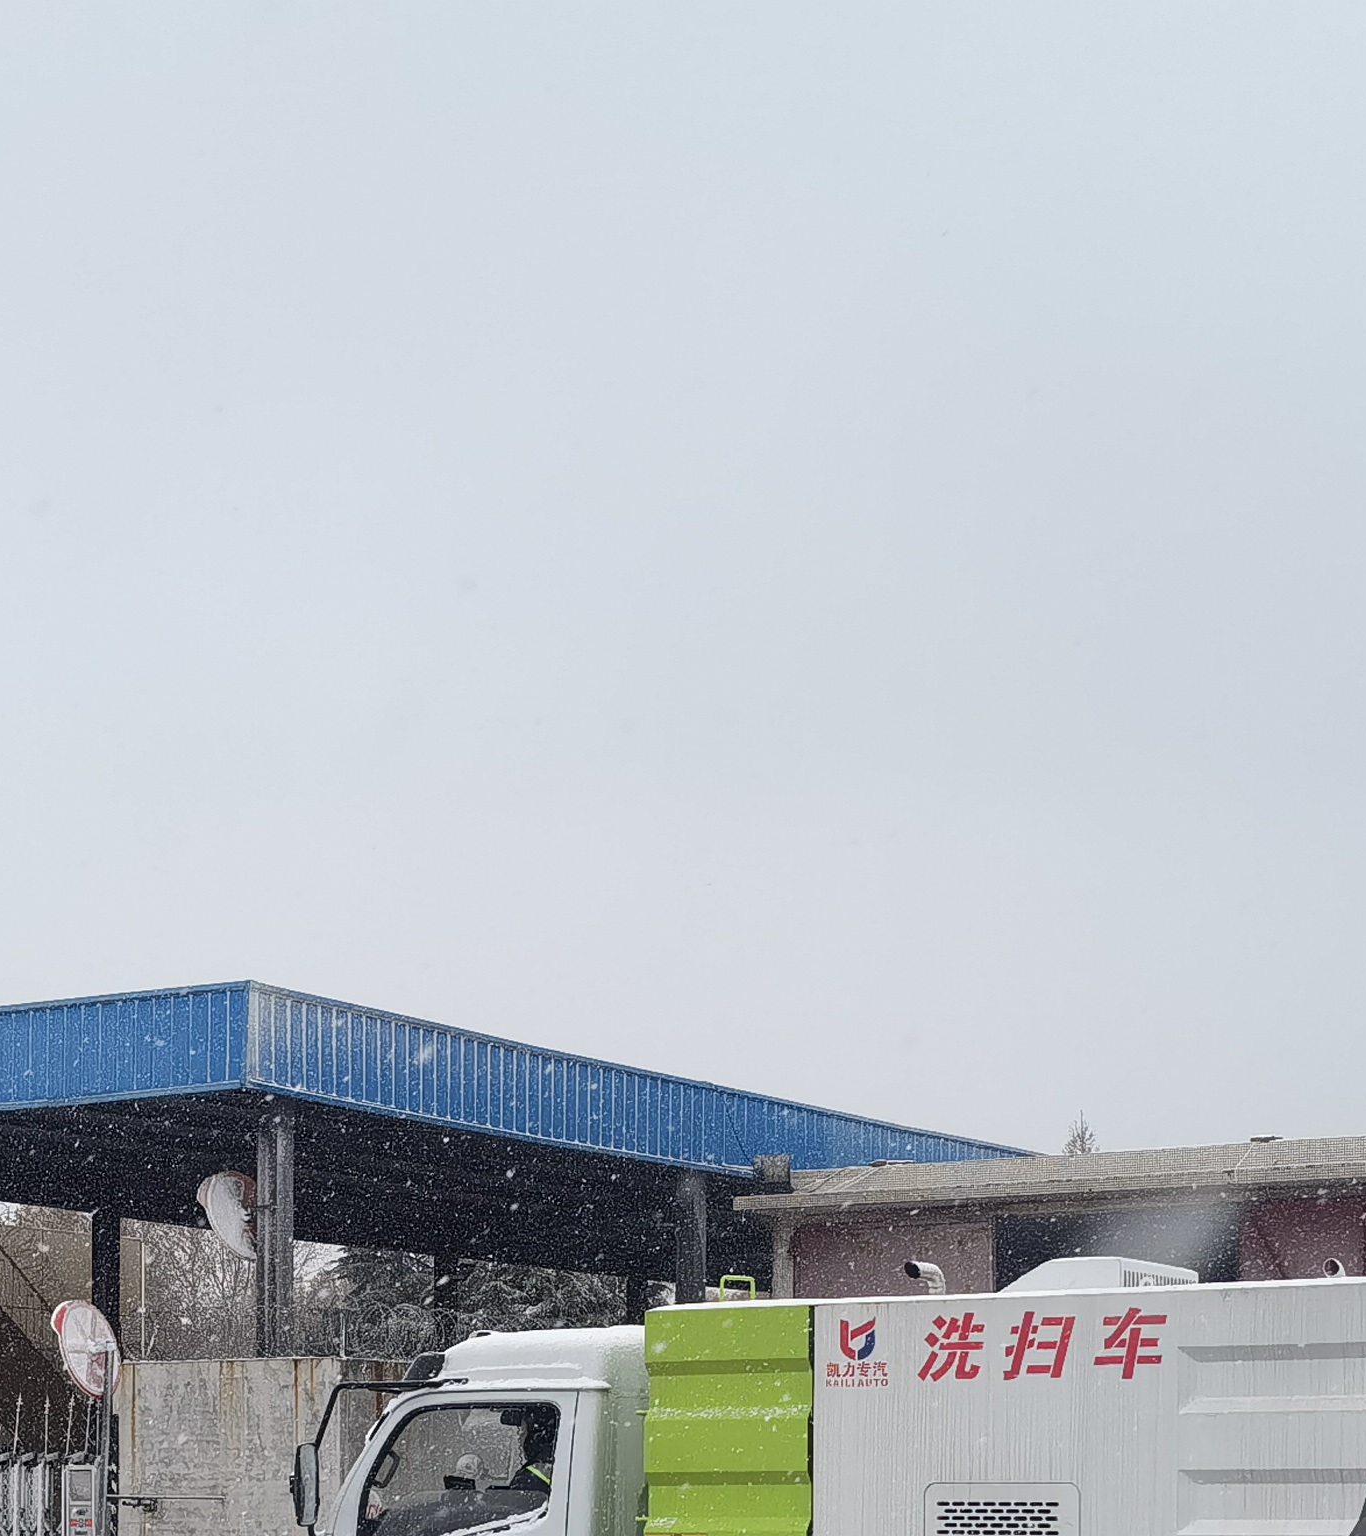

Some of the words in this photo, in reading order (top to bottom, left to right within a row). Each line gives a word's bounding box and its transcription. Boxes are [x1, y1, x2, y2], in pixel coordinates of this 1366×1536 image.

[918, 1307, 1168, 1381] 洗扫车
[826, 1361, 889, 1378] 凯力专汽
